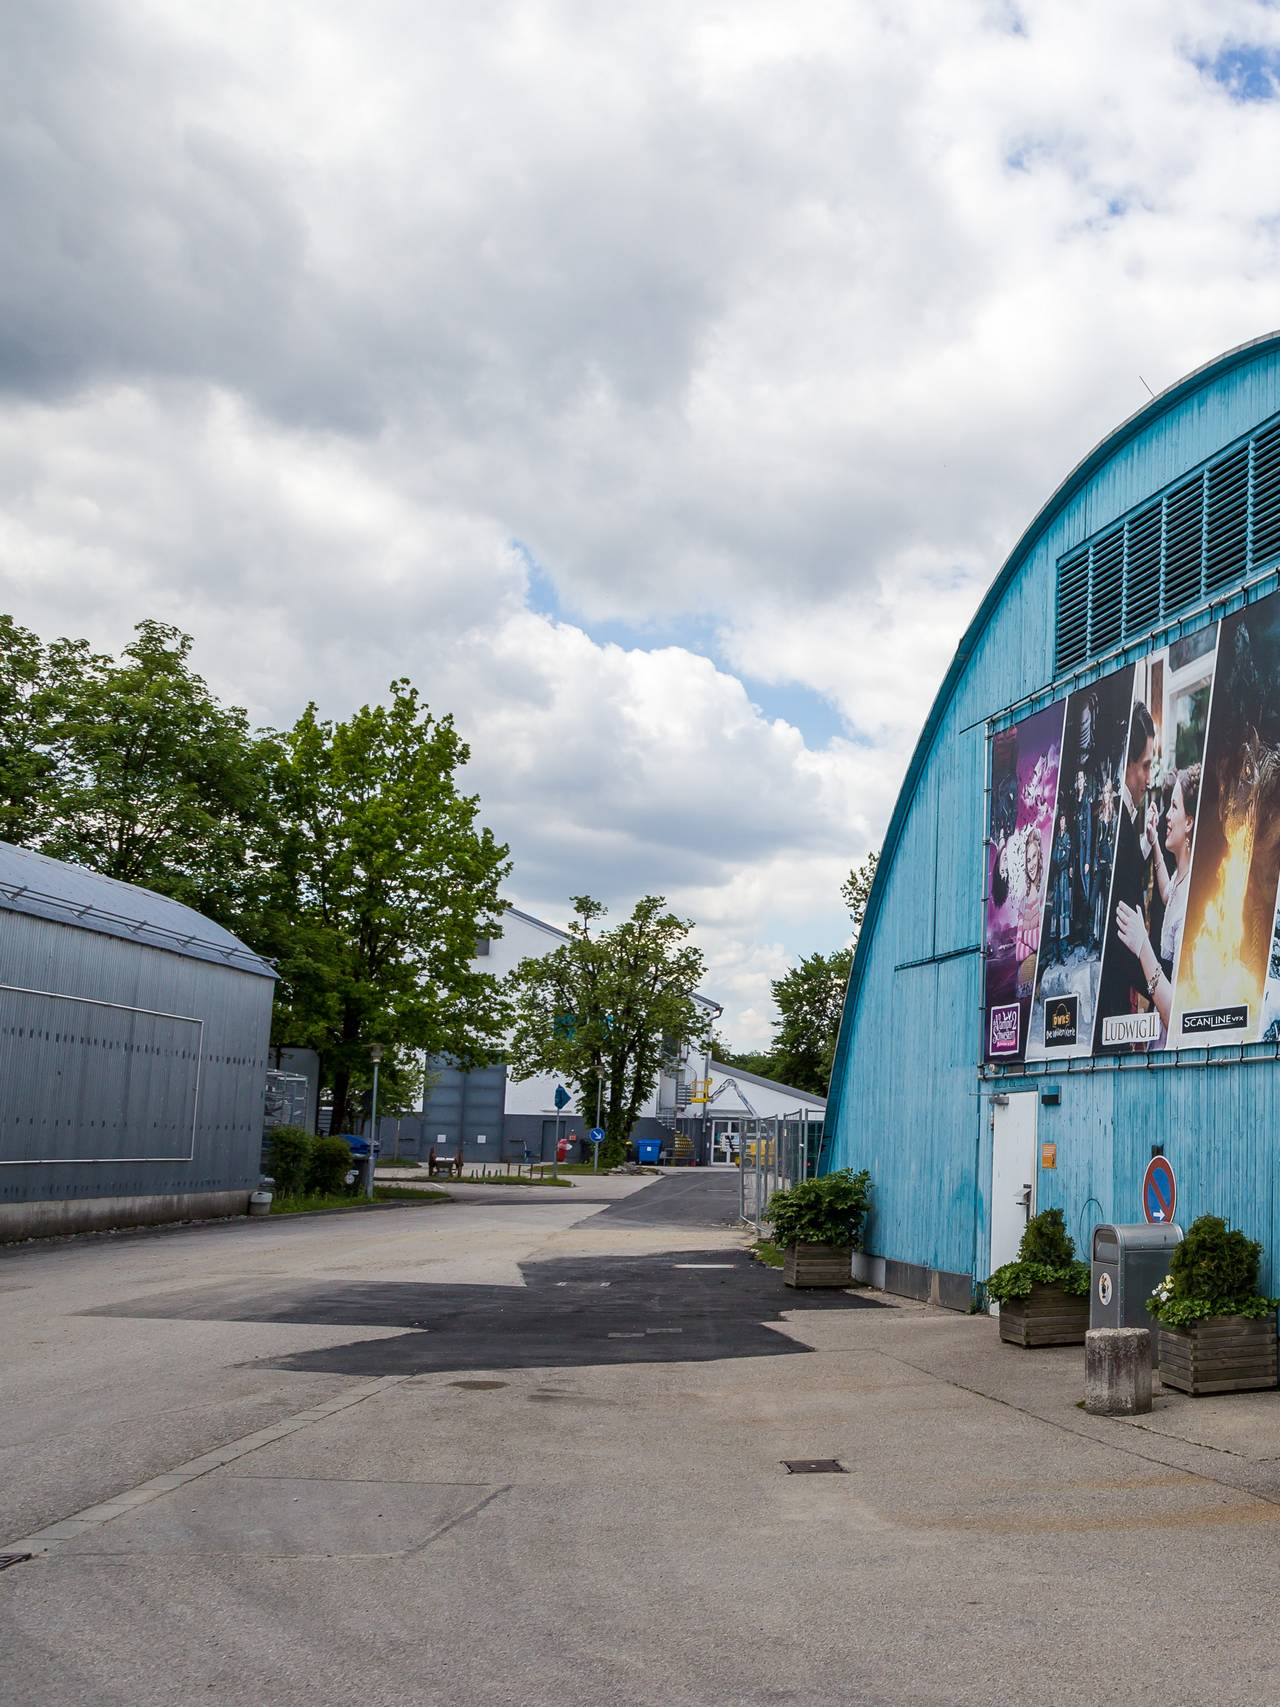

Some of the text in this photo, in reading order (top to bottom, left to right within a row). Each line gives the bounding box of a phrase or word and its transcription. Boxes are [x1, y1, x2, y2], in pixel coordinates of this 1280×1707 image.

[1104, 1015, 1158, 1041] LUDWIG II.
[1184, 1014, 1232, 1028] SCANLINE
